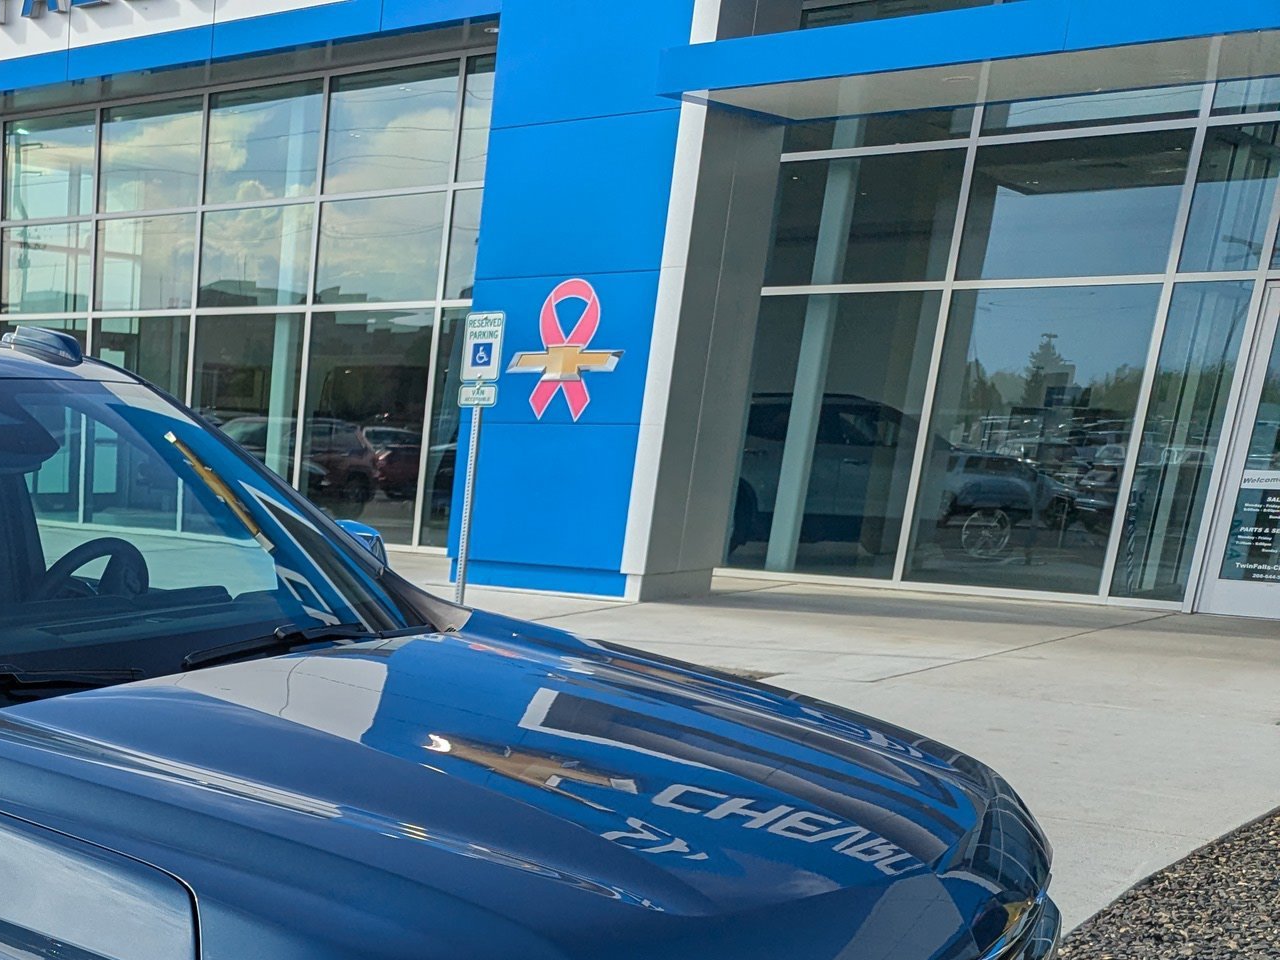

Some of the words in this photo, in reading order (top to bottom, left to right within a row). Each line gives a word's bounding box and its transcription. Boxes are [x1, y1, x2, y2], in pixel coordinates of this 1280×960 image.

[468, 318, 502, 328] RESERVED
[469, 330, 499, 340] PARKING
[1235, 562, 1280, 570] TwinFalls-C
